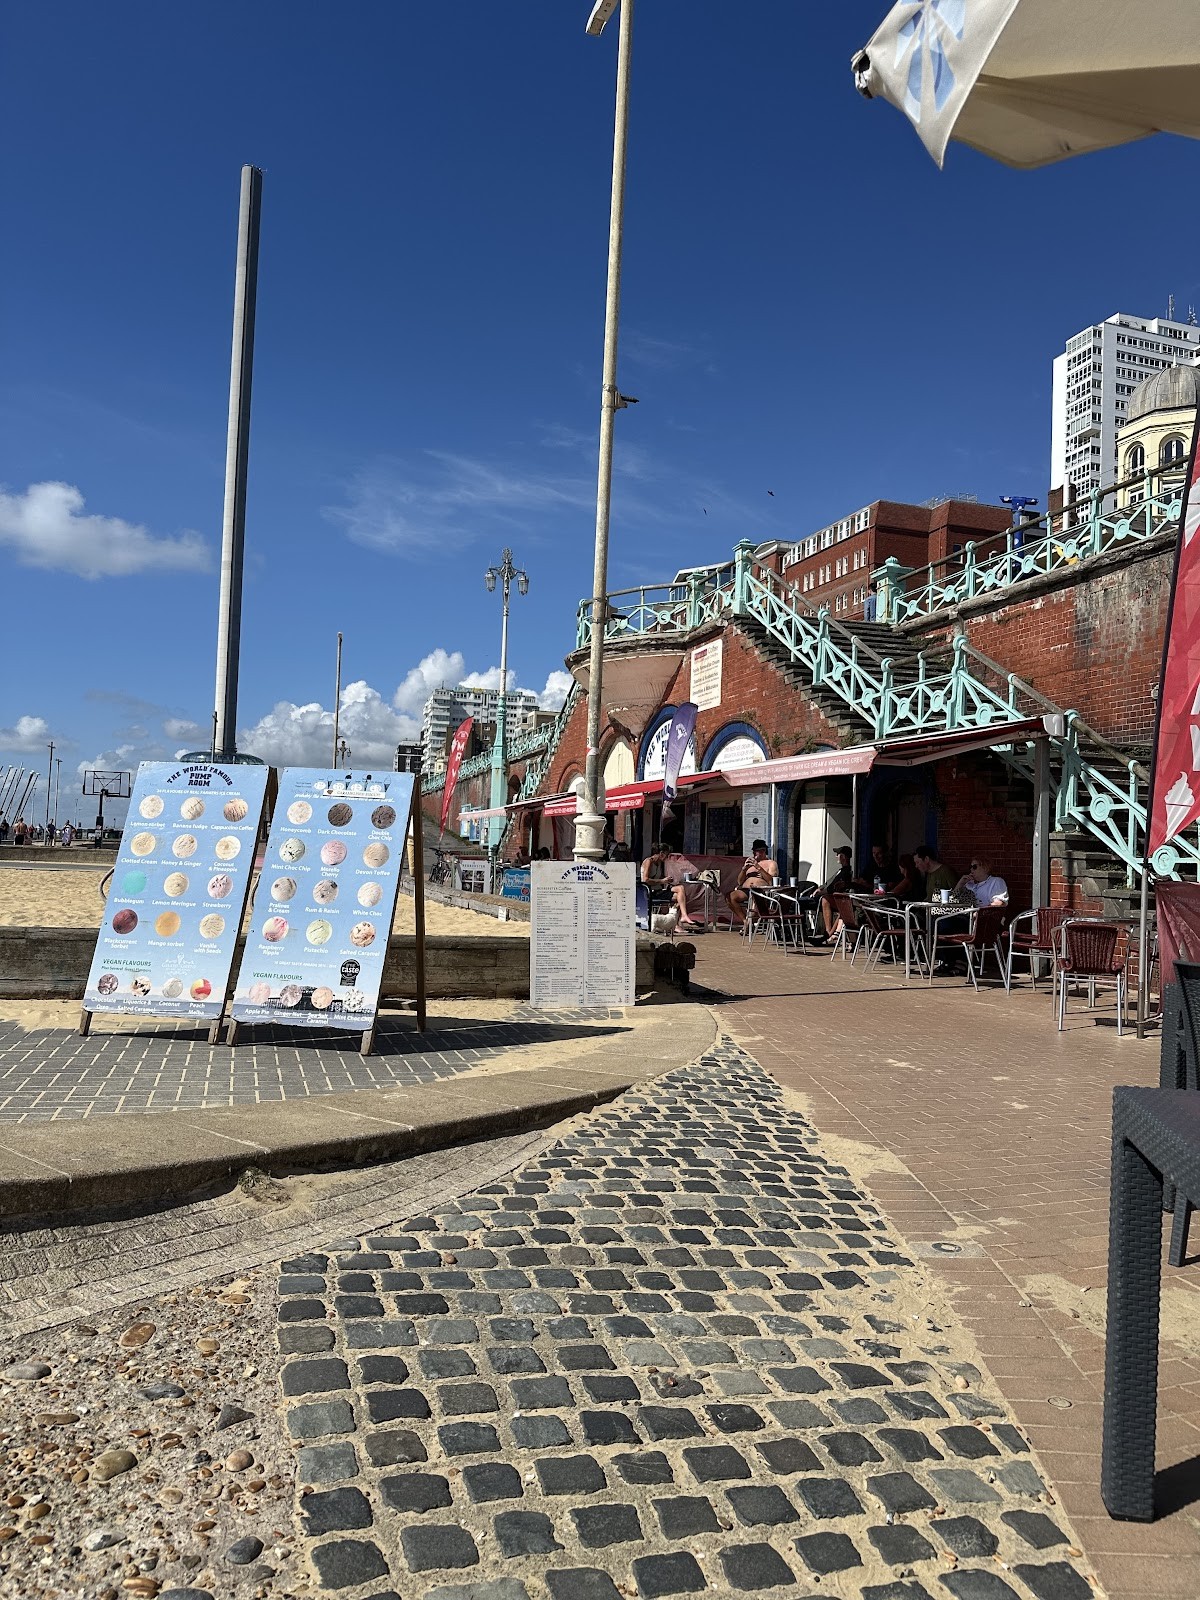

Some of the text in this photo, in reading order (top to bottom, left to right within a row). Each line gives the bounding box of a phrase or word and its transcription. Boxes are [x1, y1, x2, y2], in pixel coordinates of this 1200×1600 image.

[646, 724, 670, 764] THE WORL
[167, 766, 233, 786] THE WORLD FAMOUS
[562, 870, 571, 879] THE
[591, 866, 609, 880] FAMOUS
